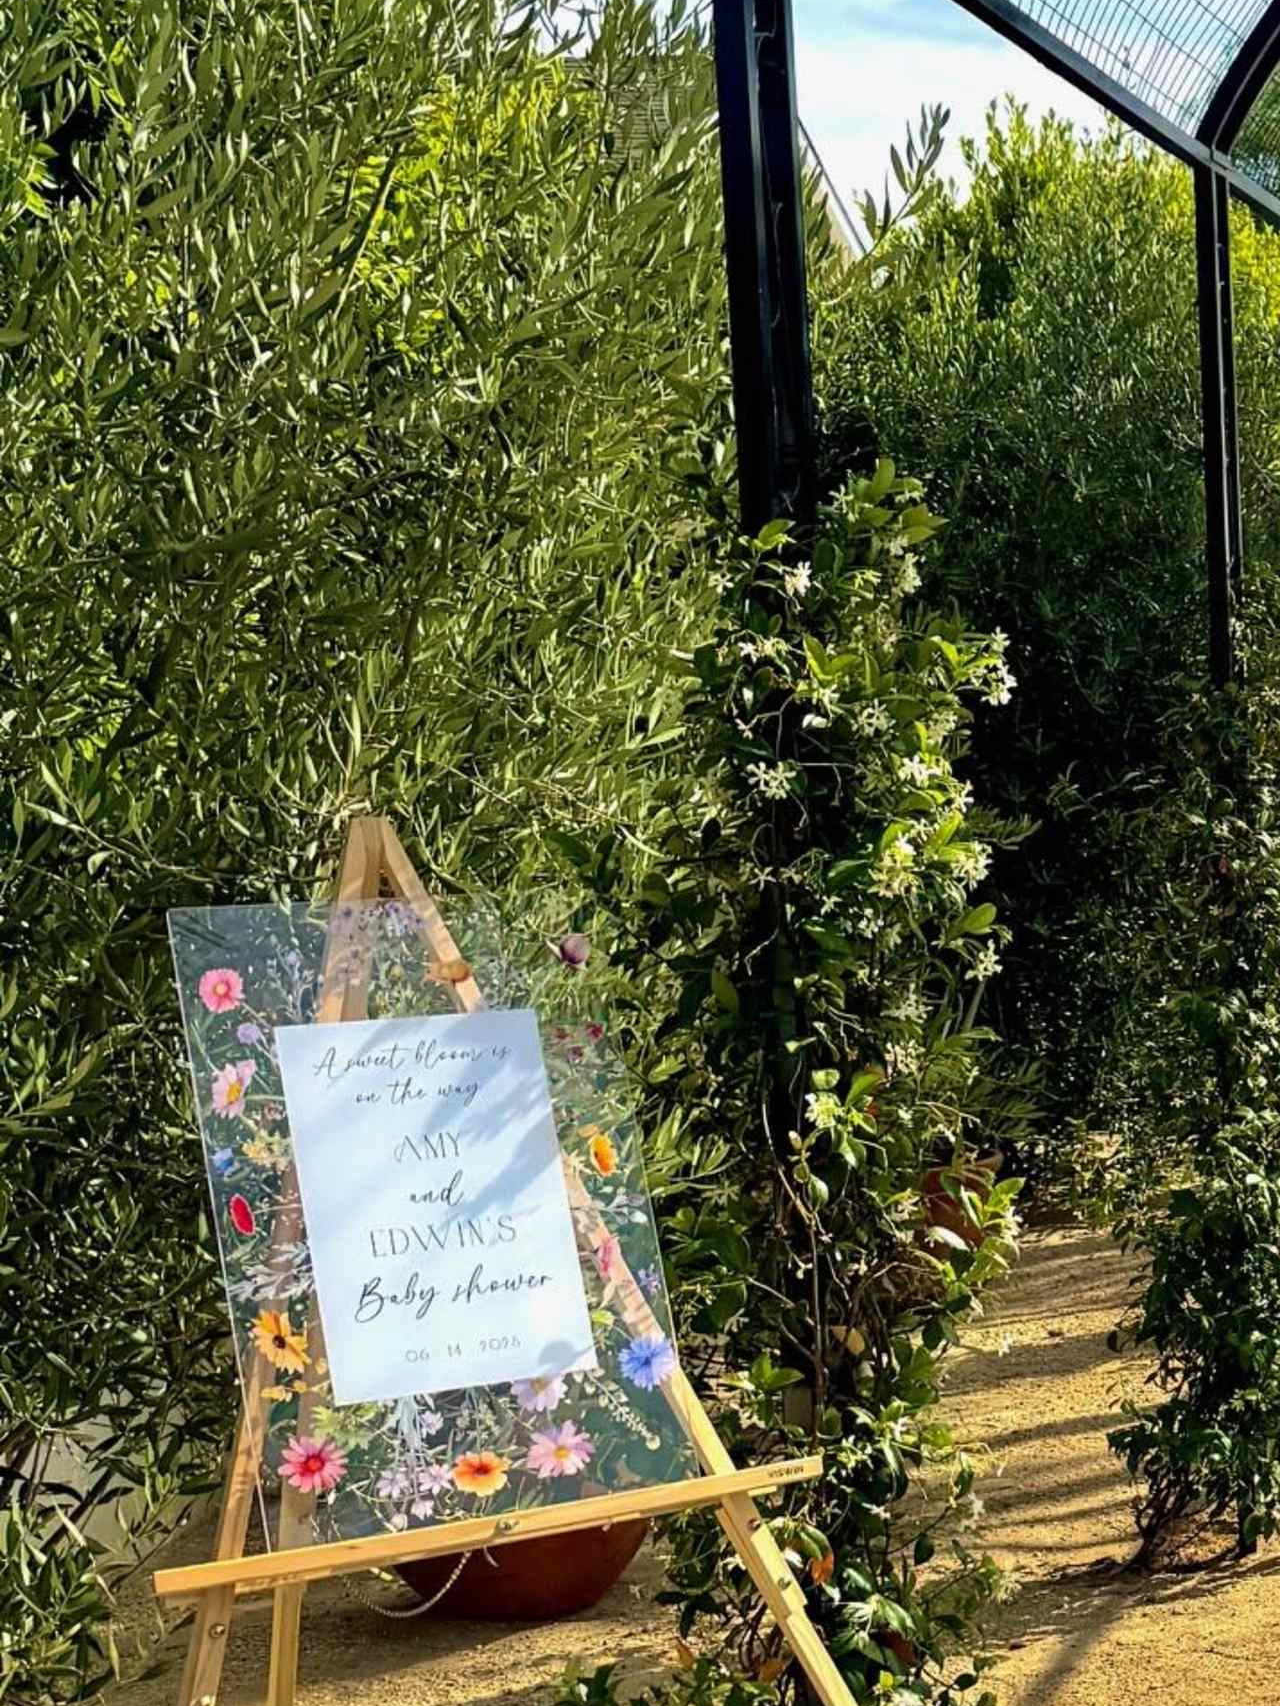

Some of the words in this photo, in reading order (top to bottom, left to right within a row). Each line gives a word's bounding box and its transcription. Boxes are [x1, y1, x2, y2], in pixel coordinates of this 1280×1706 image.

[312, 1046, 341, 1079] A
[344, 1044, 411, 1073] sweet
[415, 1039, 484, 1069] bloom
[492, 1045, 511, 1059] is
[356, 1092, 381, 1104] on
[387, 1077, 427, 1105] the
[438, 1081, 480, 1107] way
[394, 1132, 460, 1164] AMY
[410, 1169, 464, 1207] and
[370, 1214, 516, 1258] EDWIN'S
[355, 1272, 440, 1323] Baby
[451, 1263, 552, 1304] shower
